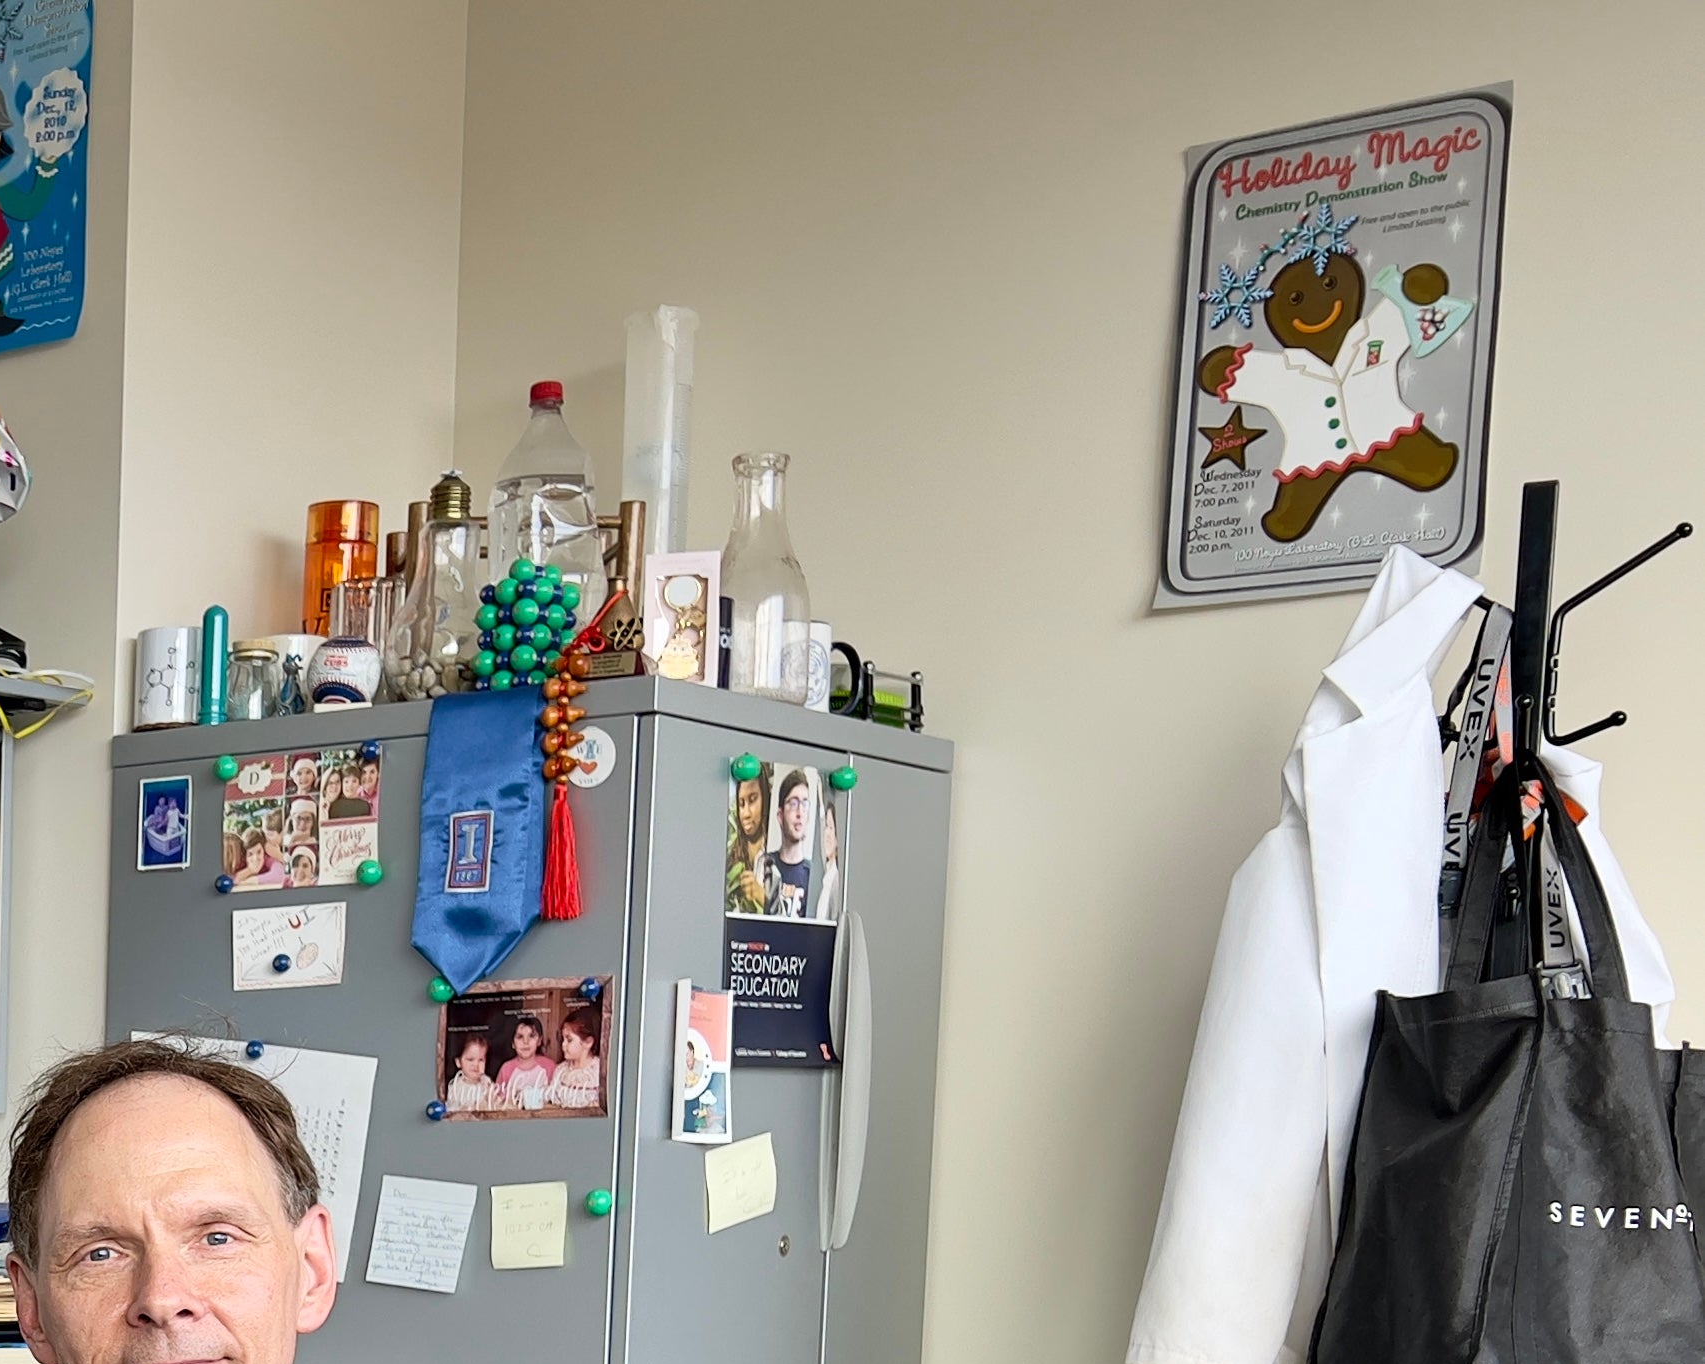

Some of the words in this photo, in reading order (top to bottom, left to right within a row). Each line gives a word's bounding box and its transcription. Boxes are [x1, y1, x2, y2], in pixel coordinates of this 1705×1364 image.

[43, 86, 77, 101] Sunday
[45, 115, 68, 128] 2010
[1217, 151, 1358, 198] Holiday
[1367, 125, 1482, 173] Magic
[1235, 199, 1302, 221] Chemistry
[1305, 178, 1404, 206] Demonstration
[1408, 170, 1448, 189] Show
[1361, 214, 1377, 226] Free
[1379, 211, 1396, 223] and
[1397, 208, 1421, 222] open
[1224, 423, 1233, 438] 2
[1212, 436, 1248, 453] Shows
[1200, 467, 1262, 484] Wednesday
[1194, 481, 1219, 497] Dec.
[1231, 480, 1255, 493] 2011
[1194, 496, 1216, 509] 7:00
[1218, 497, 1240, 508] p.m.
[1194, 515, 1241, 530] Saturday
[1187, 528, 1212, 543] Dec.
[1230, 526, 1255, 539] 2011
[1188, 543, 1210, 554] 2:00
[1211, 541, 1233, 553] p.m.
[1458, 658, 1496, 762] UVEX
[248, 771, 260, 786] D
[334, 826, 367, 848] Merry
[458, 823, 480, 865] I
[1443, 811, 1465, 872] UVE
[326, 838, 373, 868] Christmas
[1545, 866, 1567, 949] UVEX
[730, 952, 807, 977] SECONDARY
[730, 974, 800, 998] EDUCATION
